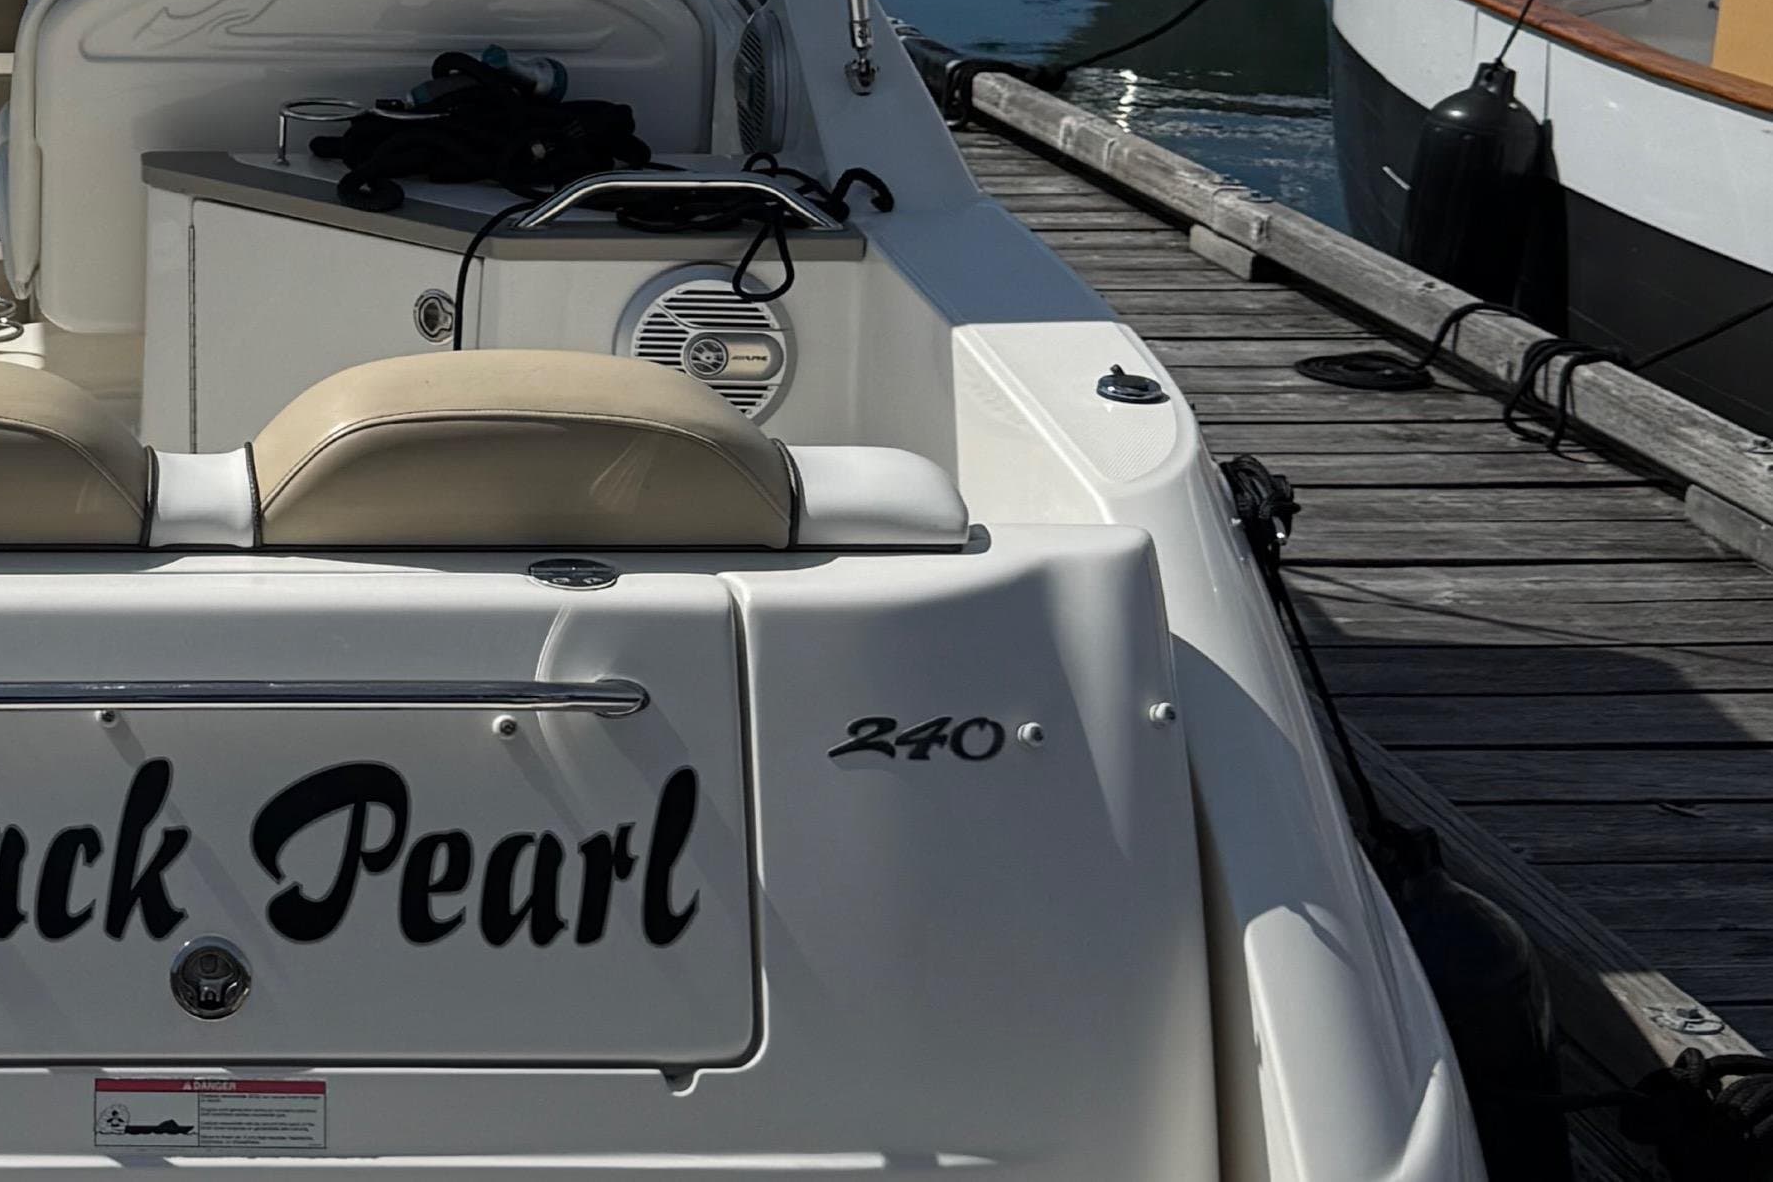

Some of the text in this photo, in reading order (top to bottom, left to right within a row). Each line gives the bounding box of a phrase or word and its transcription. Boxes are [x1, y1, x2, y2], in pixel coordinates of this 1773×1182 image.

[828, 716, 1007, 763] 240
[249, 760, 701, 950] Pearl
[192, 1080, 237, 1091] DANGER
